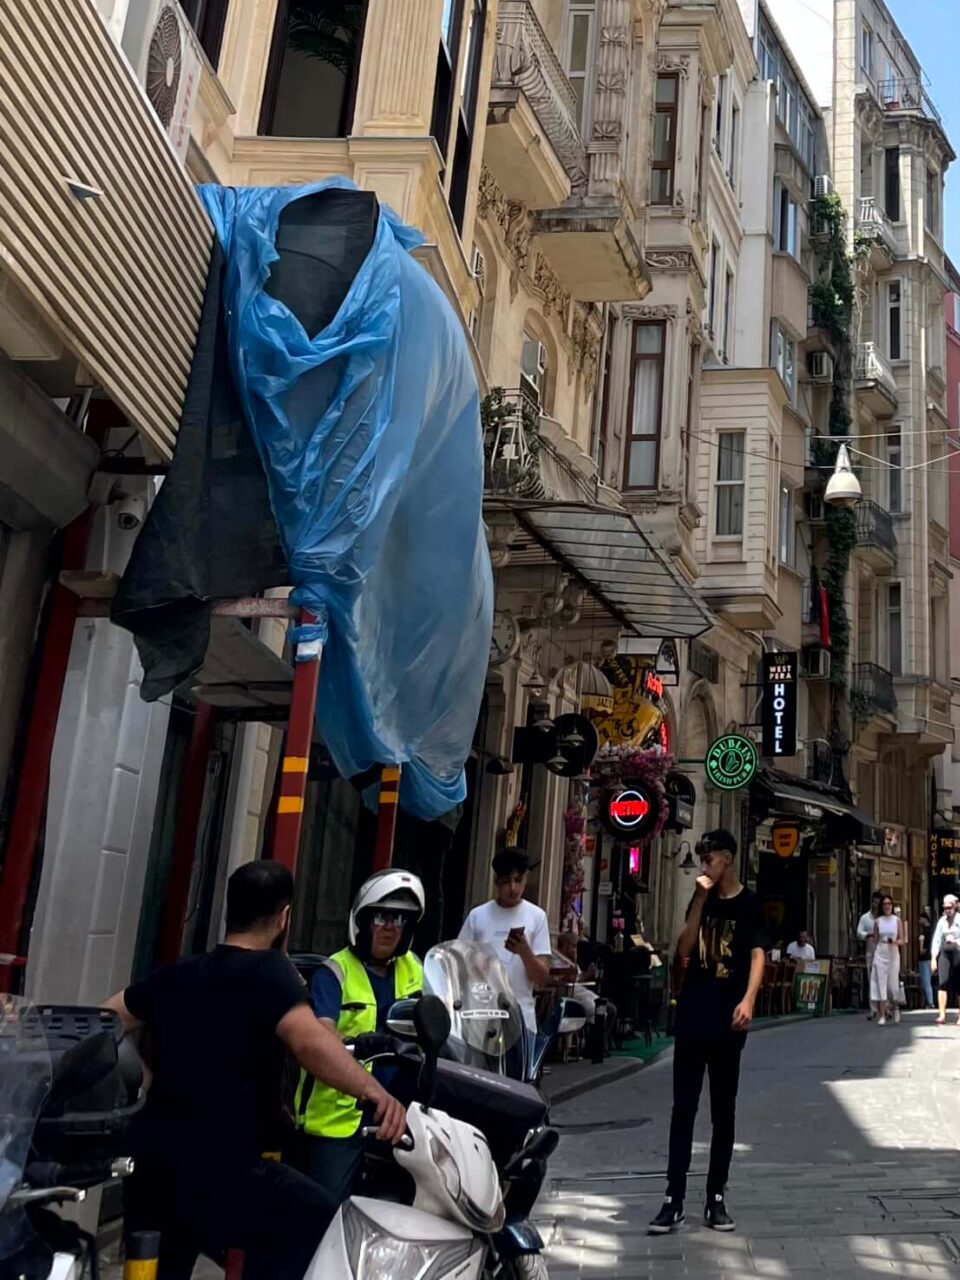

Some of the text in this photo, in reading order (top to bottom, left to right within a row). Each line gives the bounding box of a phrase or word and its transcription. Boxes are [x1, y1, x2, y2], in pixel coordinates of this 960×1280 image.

[769, 664, 792, 673] WEST
[769, 672, 792, 680] PERA
[773, 683, 786, 753] HOTEL
[712, 739, 753, 761] DUBLIN
[712, 768, 748, 785] IRISH PUB
